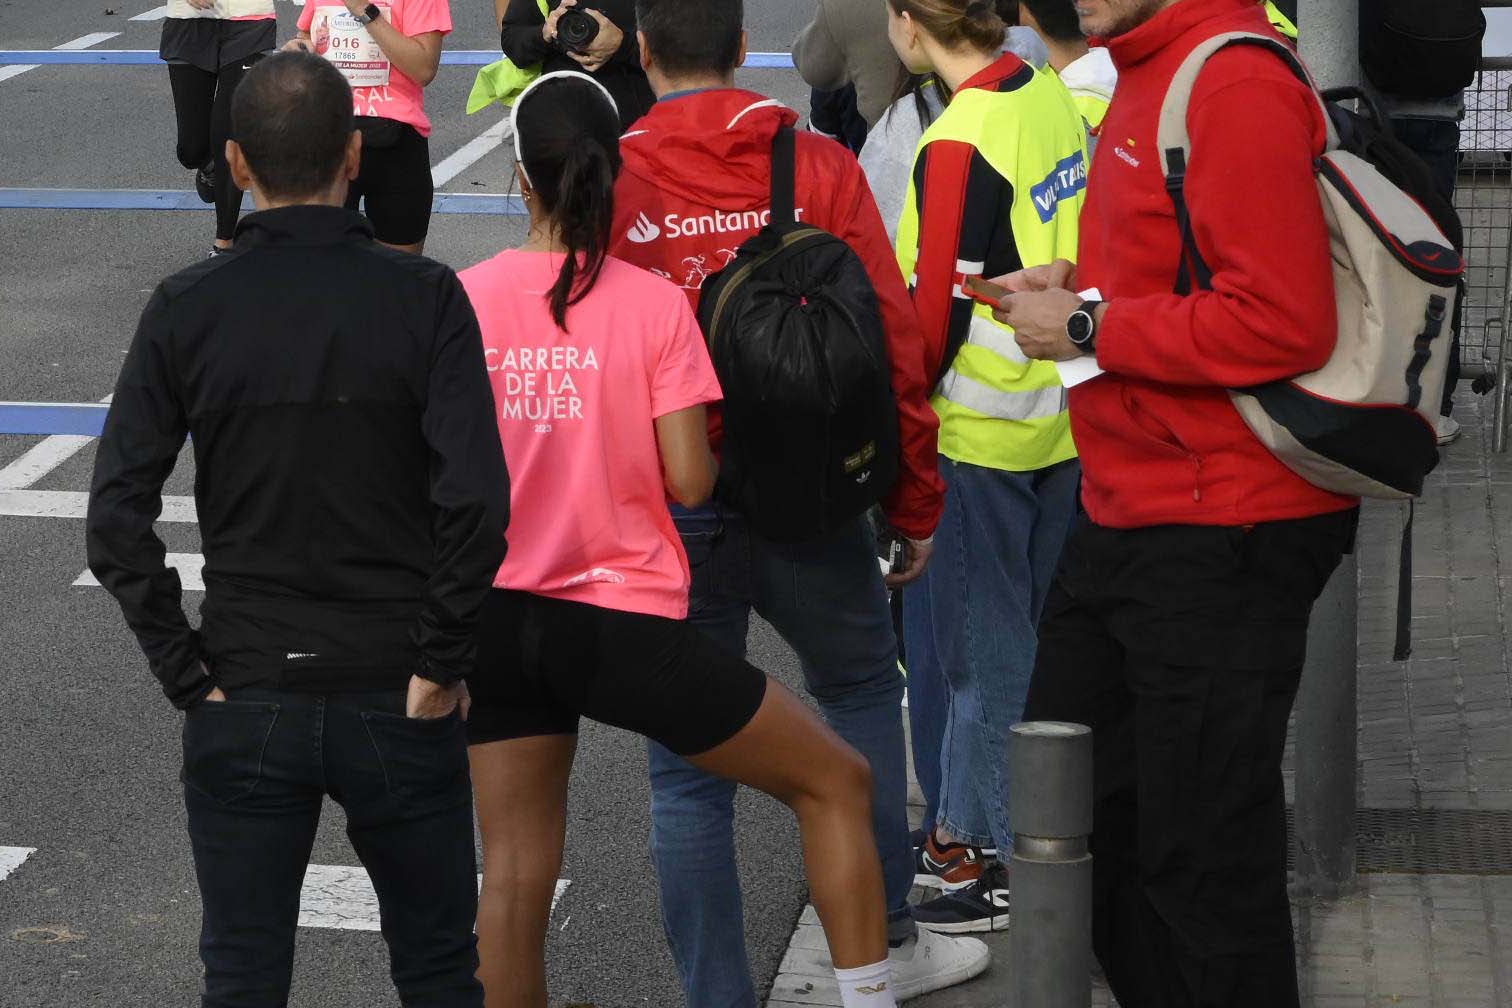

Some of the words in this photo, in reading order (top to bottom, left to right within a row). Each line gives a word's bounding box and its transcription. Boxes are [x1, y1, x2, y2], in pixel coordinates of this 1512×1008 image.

[332, 37, 360, 49] 016
[334, 52, 356, 60] 17865
[485, 346, 599, 372] CARRERA
[506, 372, 536, 395] DE
[547, 372, 577, 395] LA
[502, 396, 584, 420] MUJER
